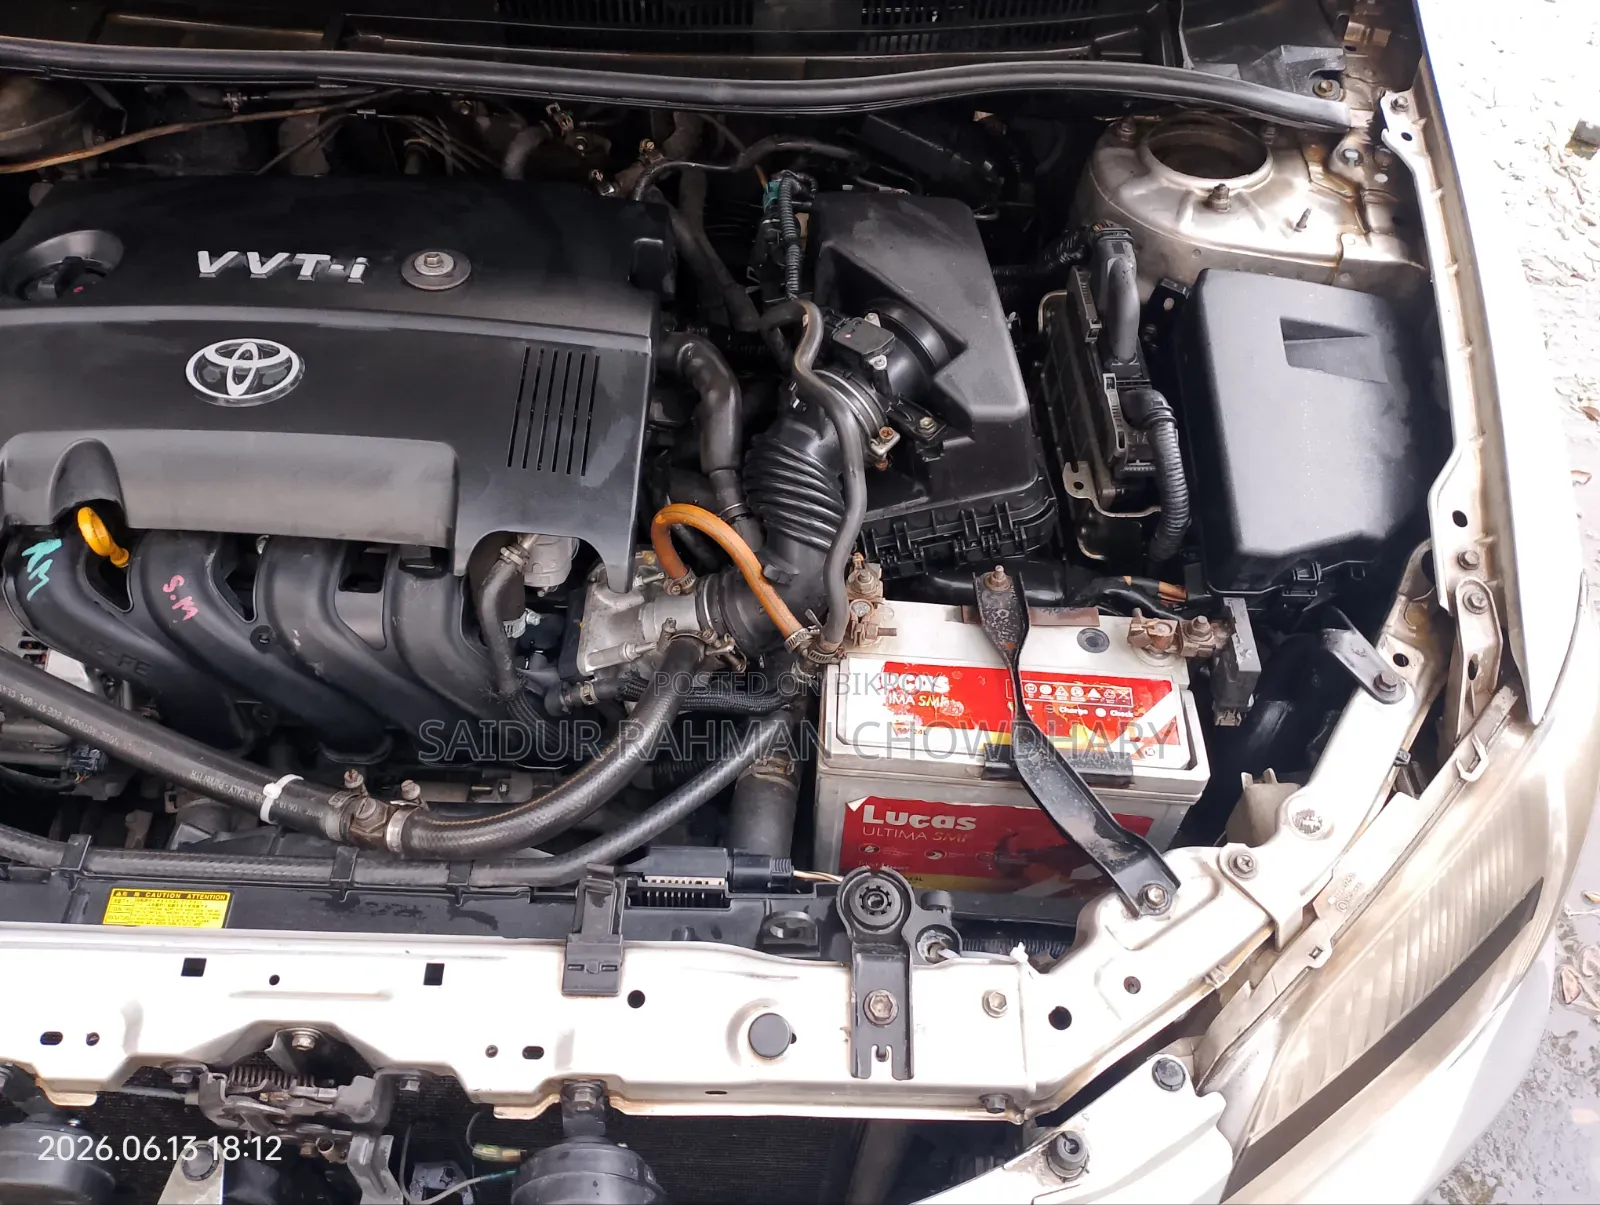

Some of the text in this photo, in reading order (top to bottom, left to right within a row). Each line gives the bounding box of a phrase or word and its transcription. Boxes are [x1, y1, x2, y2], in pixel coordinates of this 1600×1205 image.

[197, 250, 369, 284] VVT-i
[1109, 708, 1134, 719] Check
[862, 804, 977, 830] Lucas
[862, 826, 927, 840] ULTIMA
[145, 891, 181, 899] CAUTION
